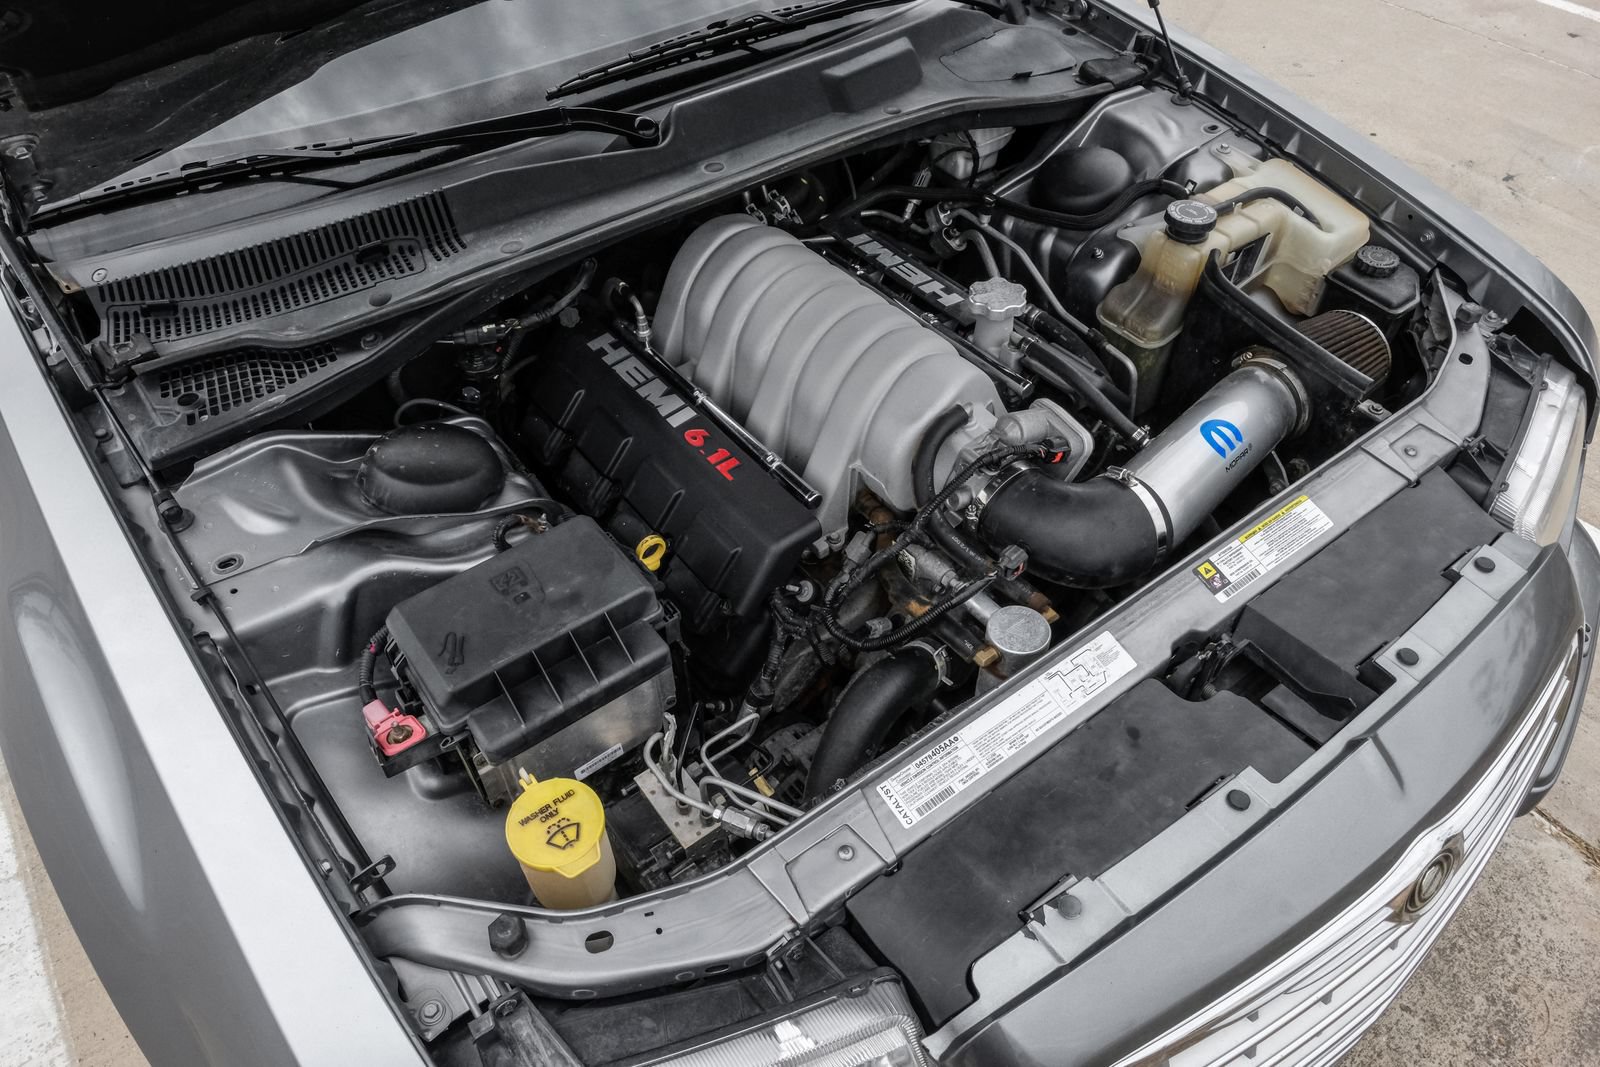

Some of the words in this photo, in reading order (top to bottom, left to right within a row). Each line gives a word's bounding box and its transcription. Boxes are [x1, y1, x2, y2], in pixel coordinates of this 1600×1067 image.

[847, 233, 965, 306] HEMI
[586, 332, 698, 428] HEMI
[683, 428, 742, 481] 6.1L
[1225, 447, 1249, 473] MOPAR
[518, 803, 552, 827] WASHER
[553, 789, 575, 806] FLUID
[539, 807, 560, 823] ONLY
[879, 785, 913, 825] CATALYST
